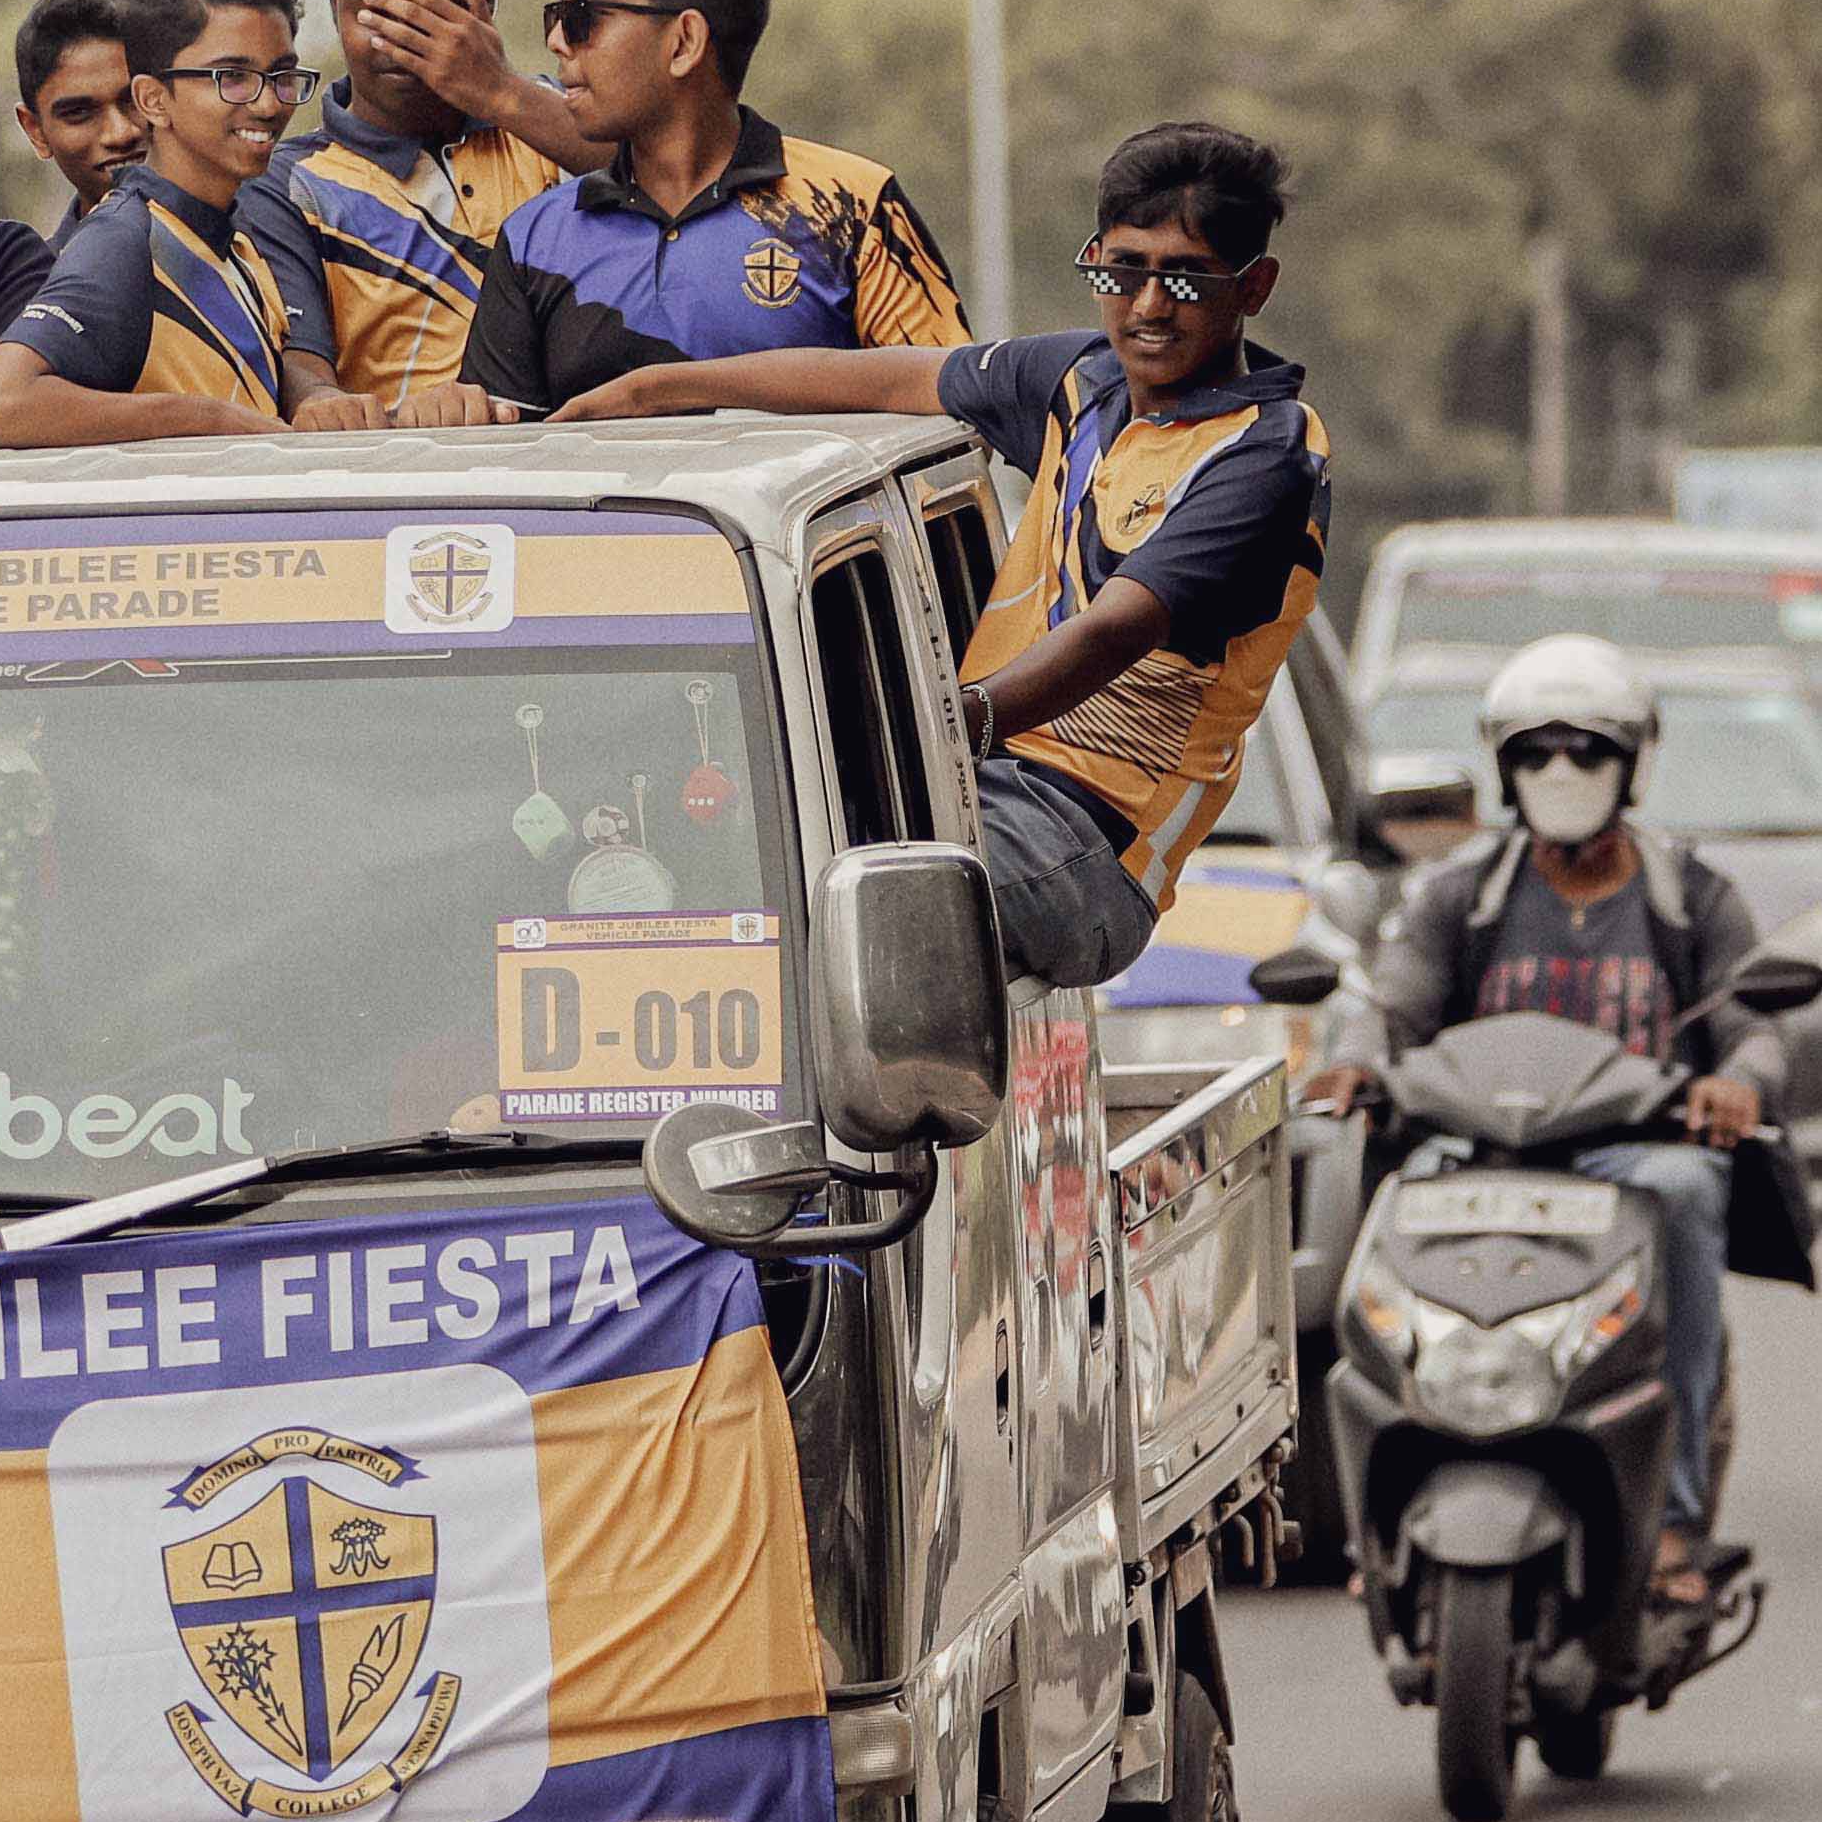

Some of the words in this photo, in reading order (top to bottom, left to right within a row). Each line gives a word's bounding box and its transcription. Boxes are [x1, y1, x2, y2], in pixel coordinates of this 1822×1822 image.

[156, 548, 327, 581] FIESTA
[26, 588, 220, 621] PARADE
[559, 921, 615, 932] GRANITE
[617, 920, 672, 930] JUBILEE
[673, 918, 718, 929] FIESTA
[585, 930, 640, 941] VEHICLE
[642, 928, 692, 939] PARADE
[506, 1093, 584, 1115] PARADE
[588, 1090, 684, 1114] REGISTER
[260, 1224, 641, 1359] FIESTA
[191, 1454, 259, 1503] DOMINO
[274, 1434, 310, 1451] PRO
[325, 1443, 394, 1484] PARTRIA
[171, 1710, 218, 1776] JOSEPH
[211, 1765, 241, 1801] VAZ
[274, 1784, 372, 1815] COLLEGE
